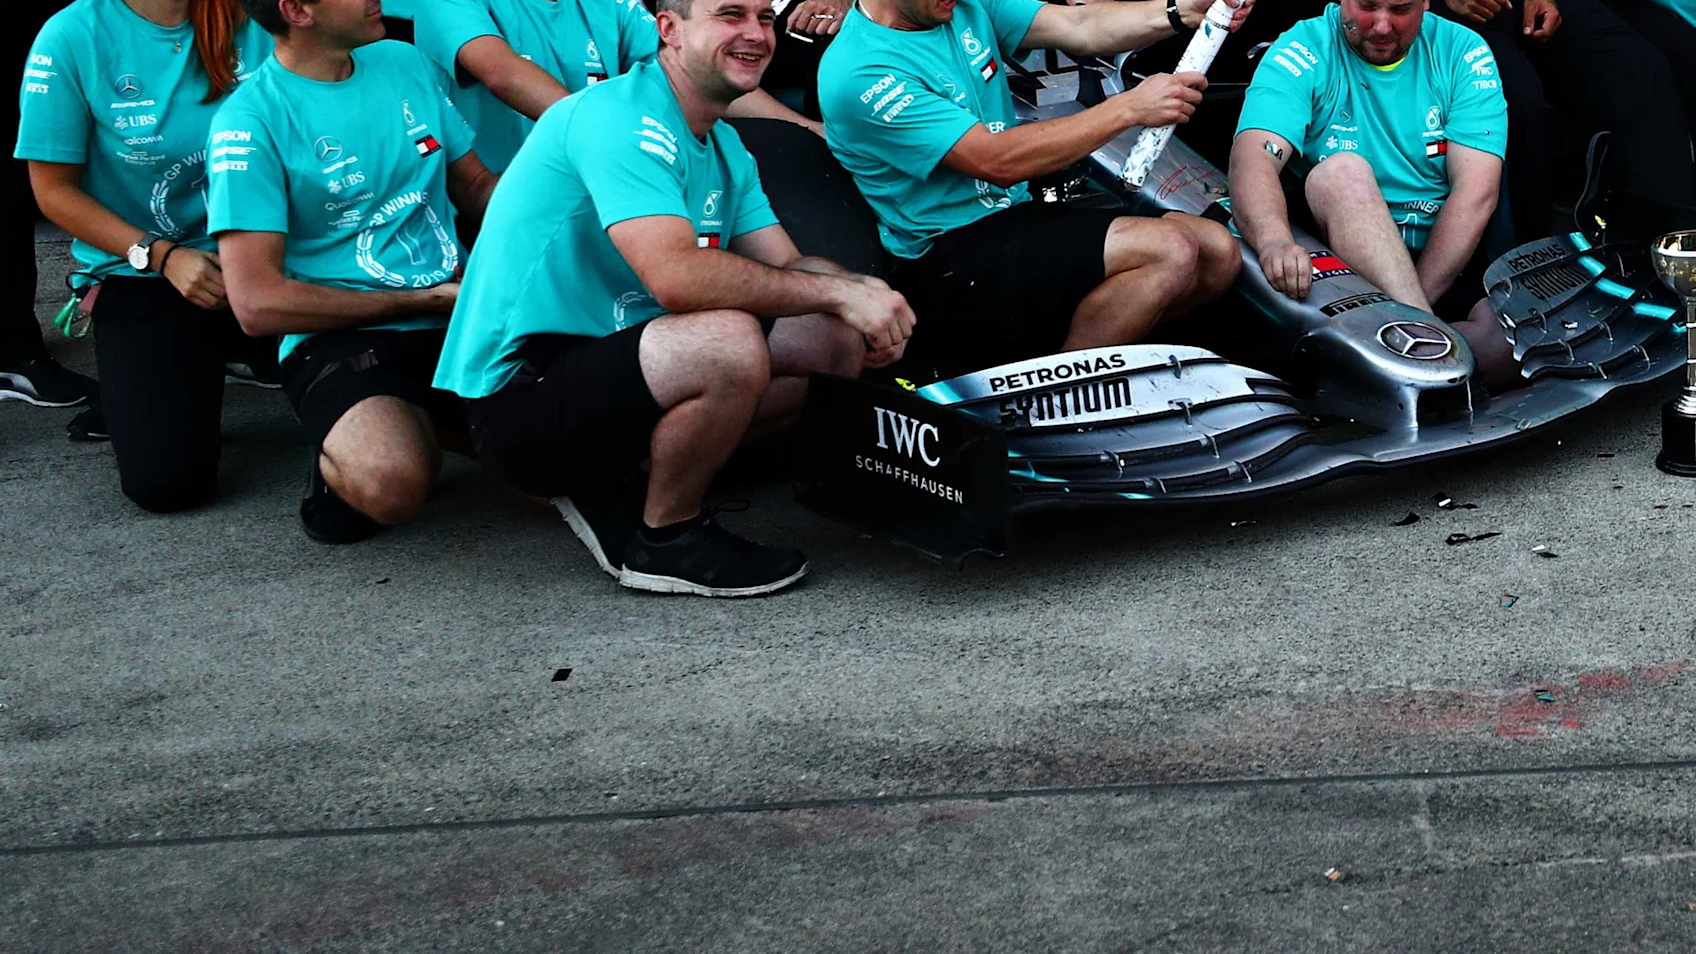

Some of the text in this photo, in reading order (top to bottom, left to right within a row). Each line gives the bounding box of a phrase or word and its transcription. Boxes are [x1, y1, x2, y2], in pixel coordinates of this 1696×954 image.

[1289, 40, 1319, 65] EPSON
[859, 73, 898, 104] EPSON
[1472, 79, 1498, 90] TIBCO
[128, 113, 157, 128] UBS
[163, 163, 182, 182] GP
[341, 171, 366, 189] UBS
[383, 191, 425, 217] WINN
[1507, 243, 1567, 273] PETRONAS
[411, 269, 447, 288] 2019
[989, 353, 1127, 393] PETRONAS
[873, 406, 941, 468] IWC
[855, 454, 964, 505] SCHAFFHAUSEN
